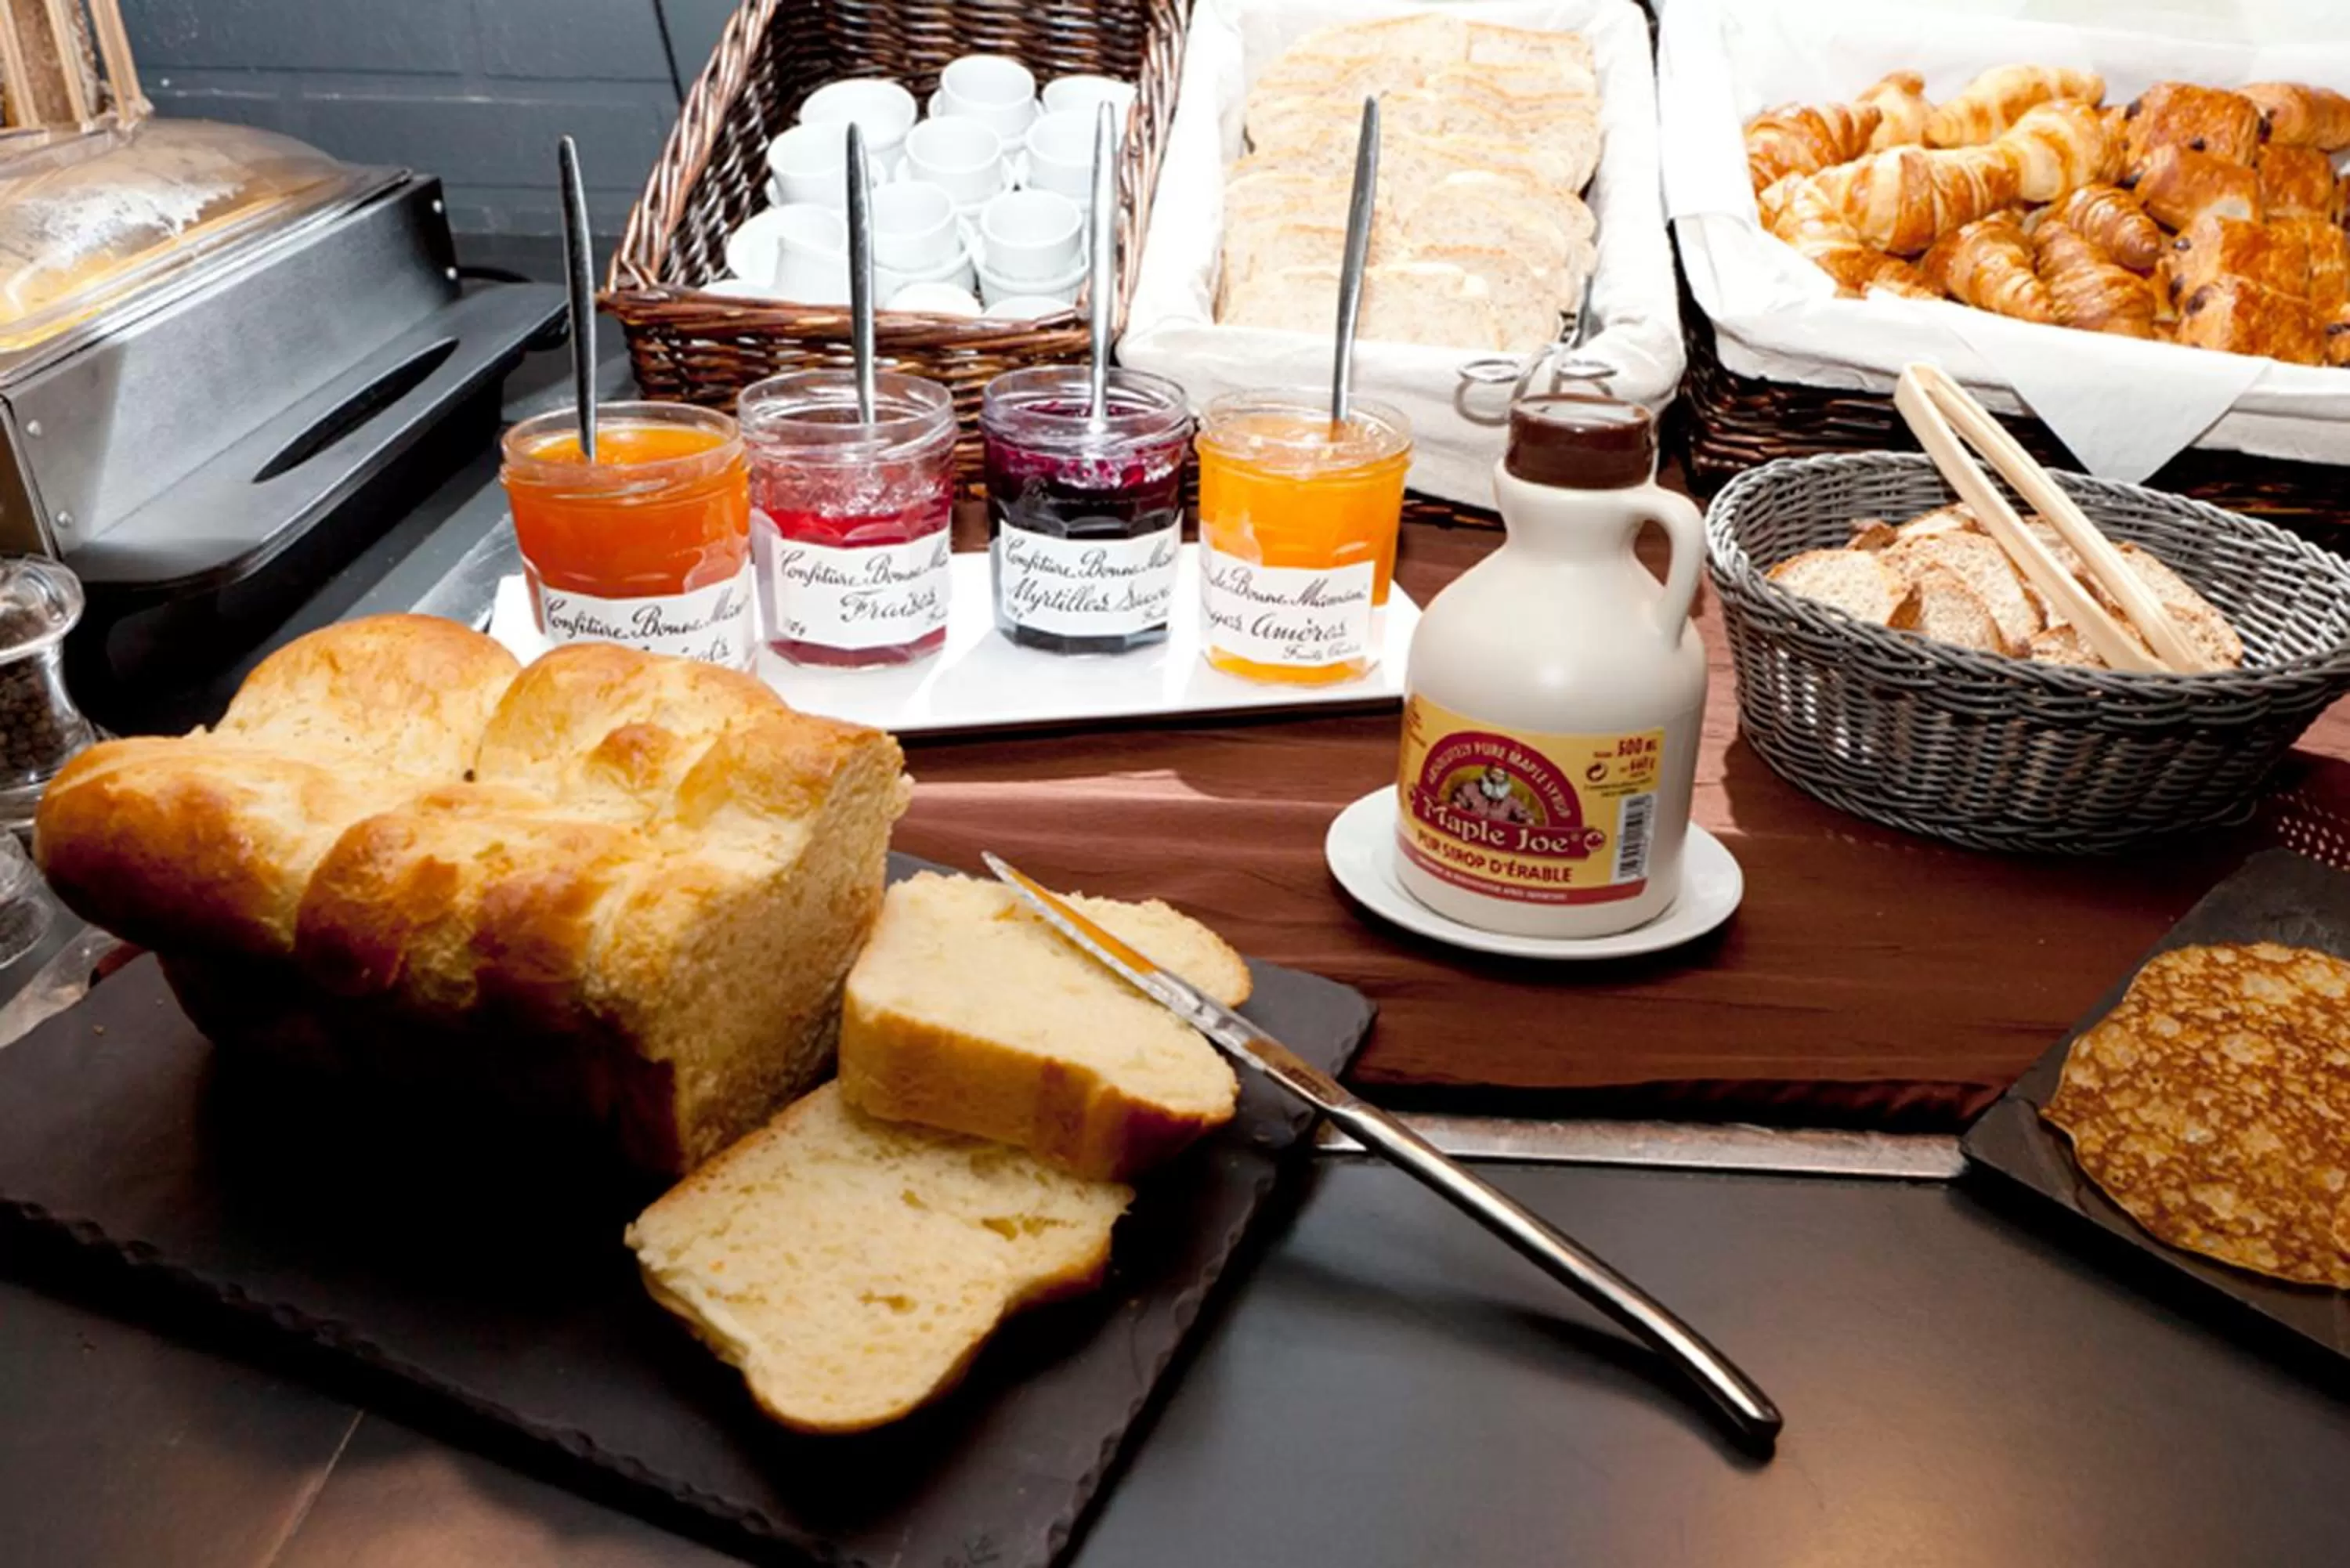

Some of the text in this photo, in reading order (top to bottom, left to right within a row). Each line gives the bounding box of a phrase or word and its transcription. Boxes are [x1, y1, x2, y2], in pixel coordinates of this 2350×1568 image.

[781, 549, 855, 587] Confiture
[1005, 535, 1072, 576] Confiture
[1079, 550, 1140, 578] Bonne
[1012, 576, 1109, 613] Myrtilles
[1230, 565, 1286, 604] Bonne
[547, 595, 624, 638] Confiture
[840, 587, 936, 623] Fraises
[1250, 612, 1347, 641] Amères
[1617, 737, 1643, 757] 500
[1473, 742, 1505, 760] PURE
[1507, 750, 1549, 784] MAPLE
[1544, 778, 1572, 819] SYRUP
[1423, 798, 1506, 847] Maple
[1417, 829, 1441, 854] PUR
[1442, 844, 1488, 870] SIROP
[1490, 858, 1574, 883] D'ÉRABLE
